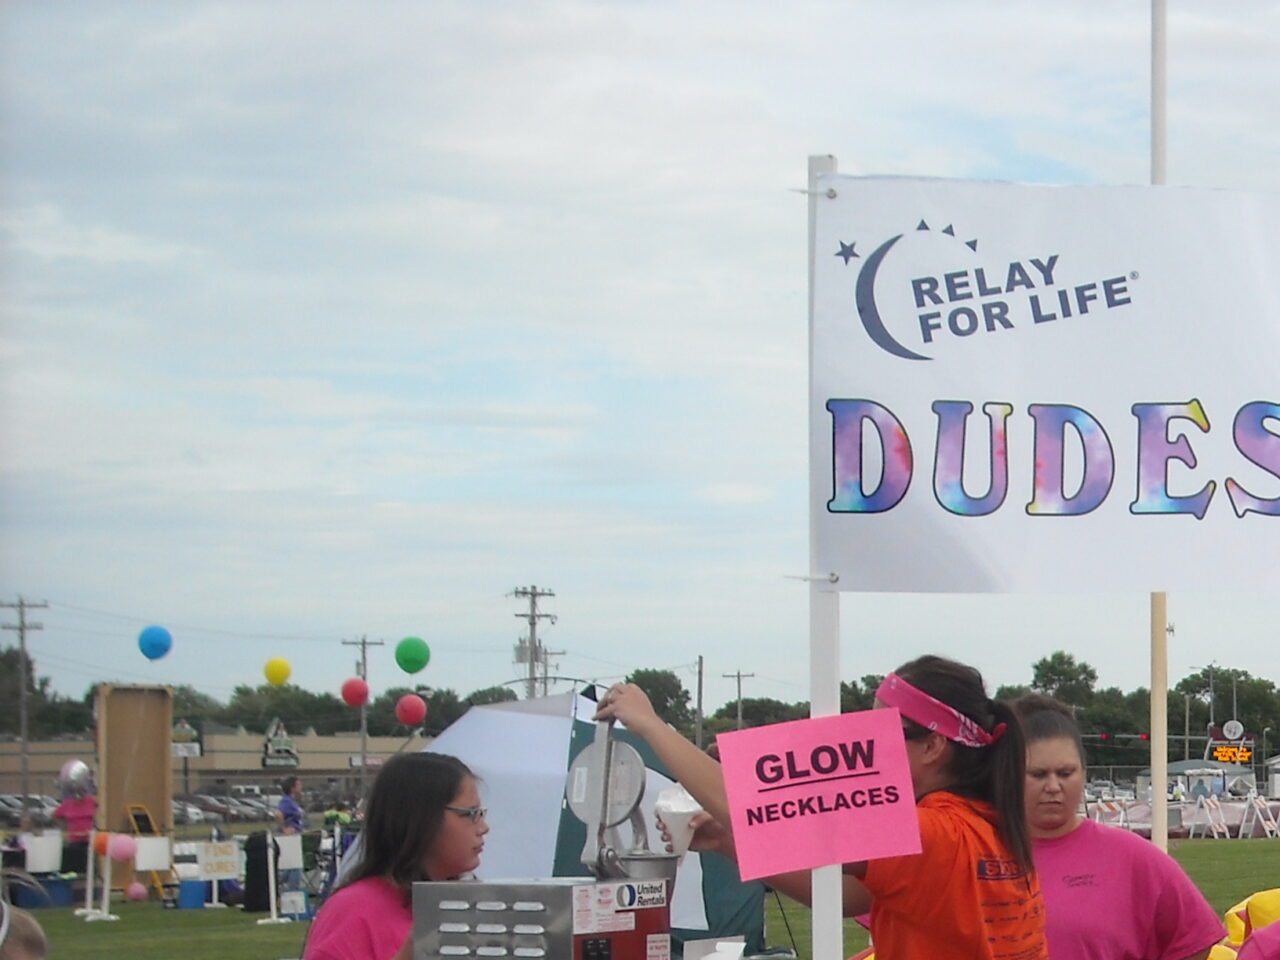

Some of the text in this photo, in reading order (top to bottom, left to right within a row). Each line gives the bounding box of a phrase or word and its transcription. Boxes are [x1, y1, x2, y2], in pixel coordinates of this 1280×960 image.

[911, 254, 1060, 309] RELAY
[918, 300, 1015, 344] FOR
[755, 739, 875, 784] GLOW
[746, 785, 900, 826] NECKLACES
[637, 882, 663, 895] United
[637, 894, 665, 907] Rentals
